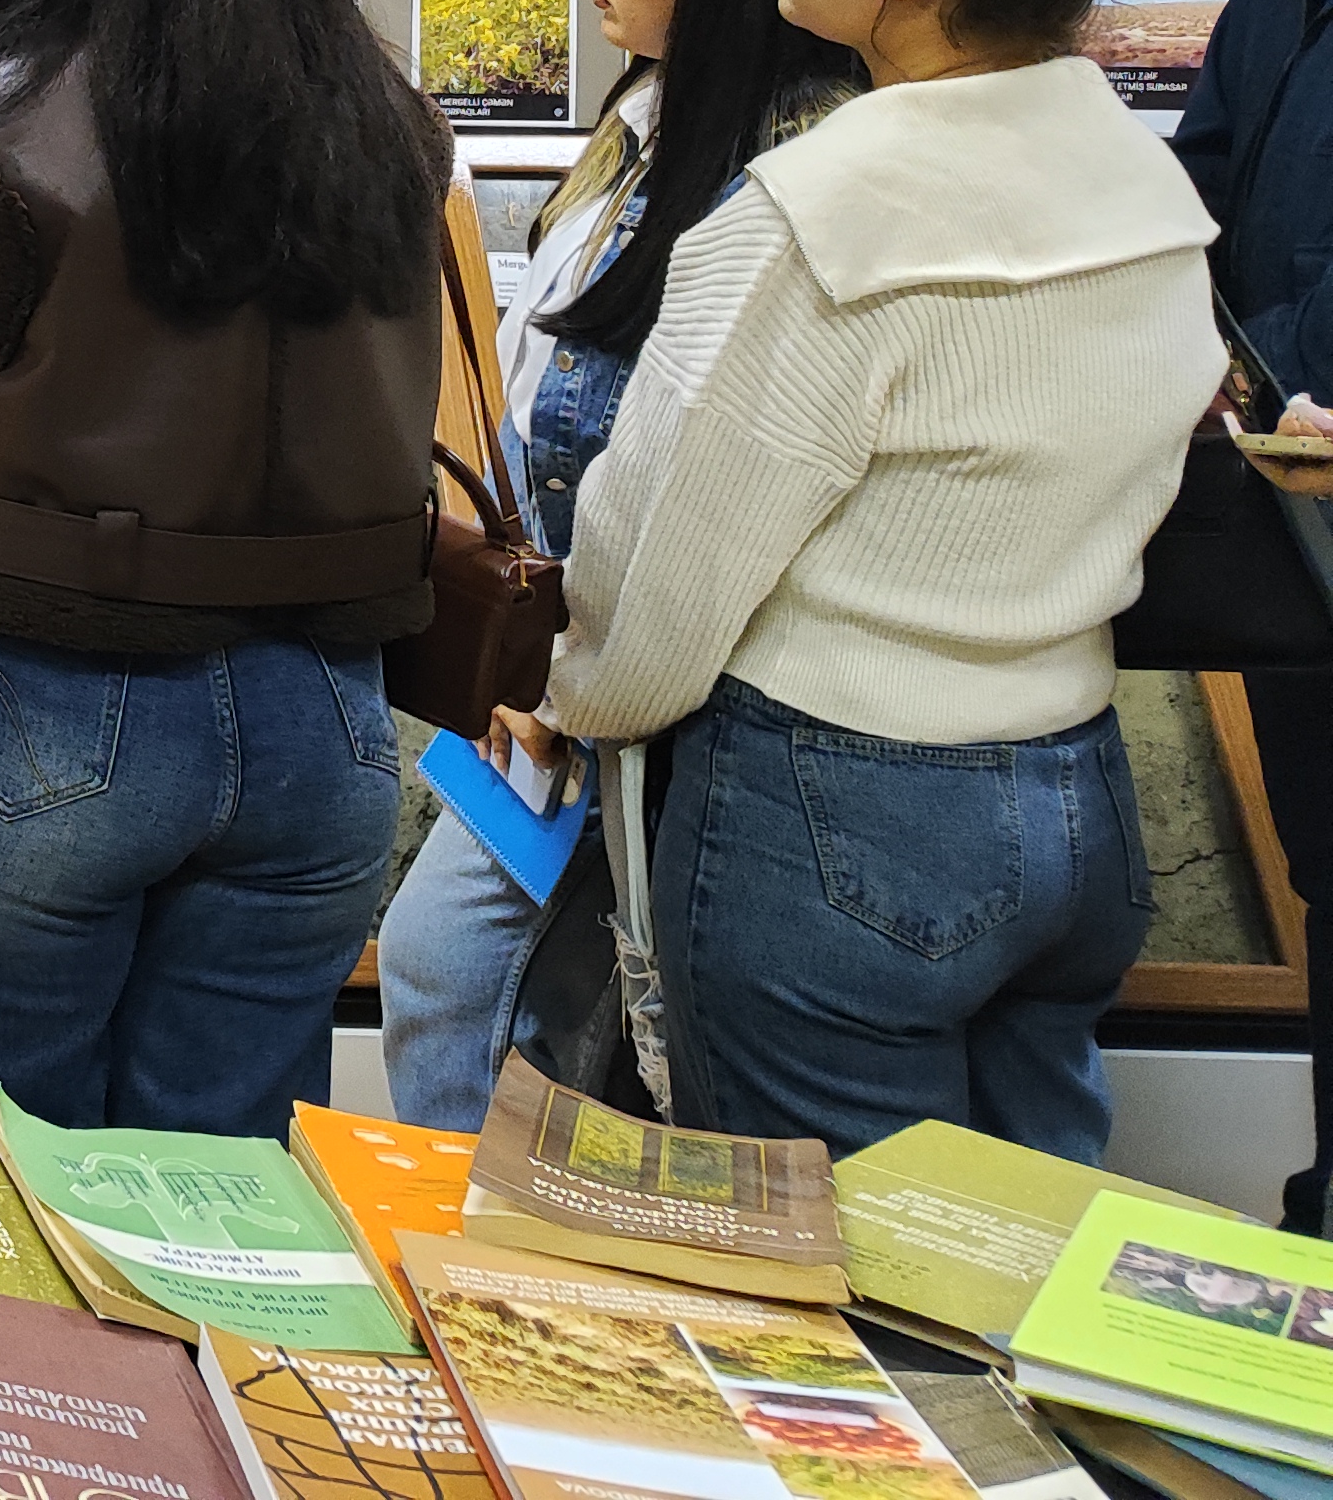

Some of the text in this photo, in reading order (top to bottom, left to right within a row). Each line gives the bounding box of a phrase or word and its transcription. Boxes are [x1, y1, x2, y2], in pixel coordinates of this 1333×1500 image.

[443, 107, 491, 116] ORPAQLARI
[160, 1245, 264, 1264] АТМОСФЕРА
[346, 1395, 453, 1417] СТЫХ
